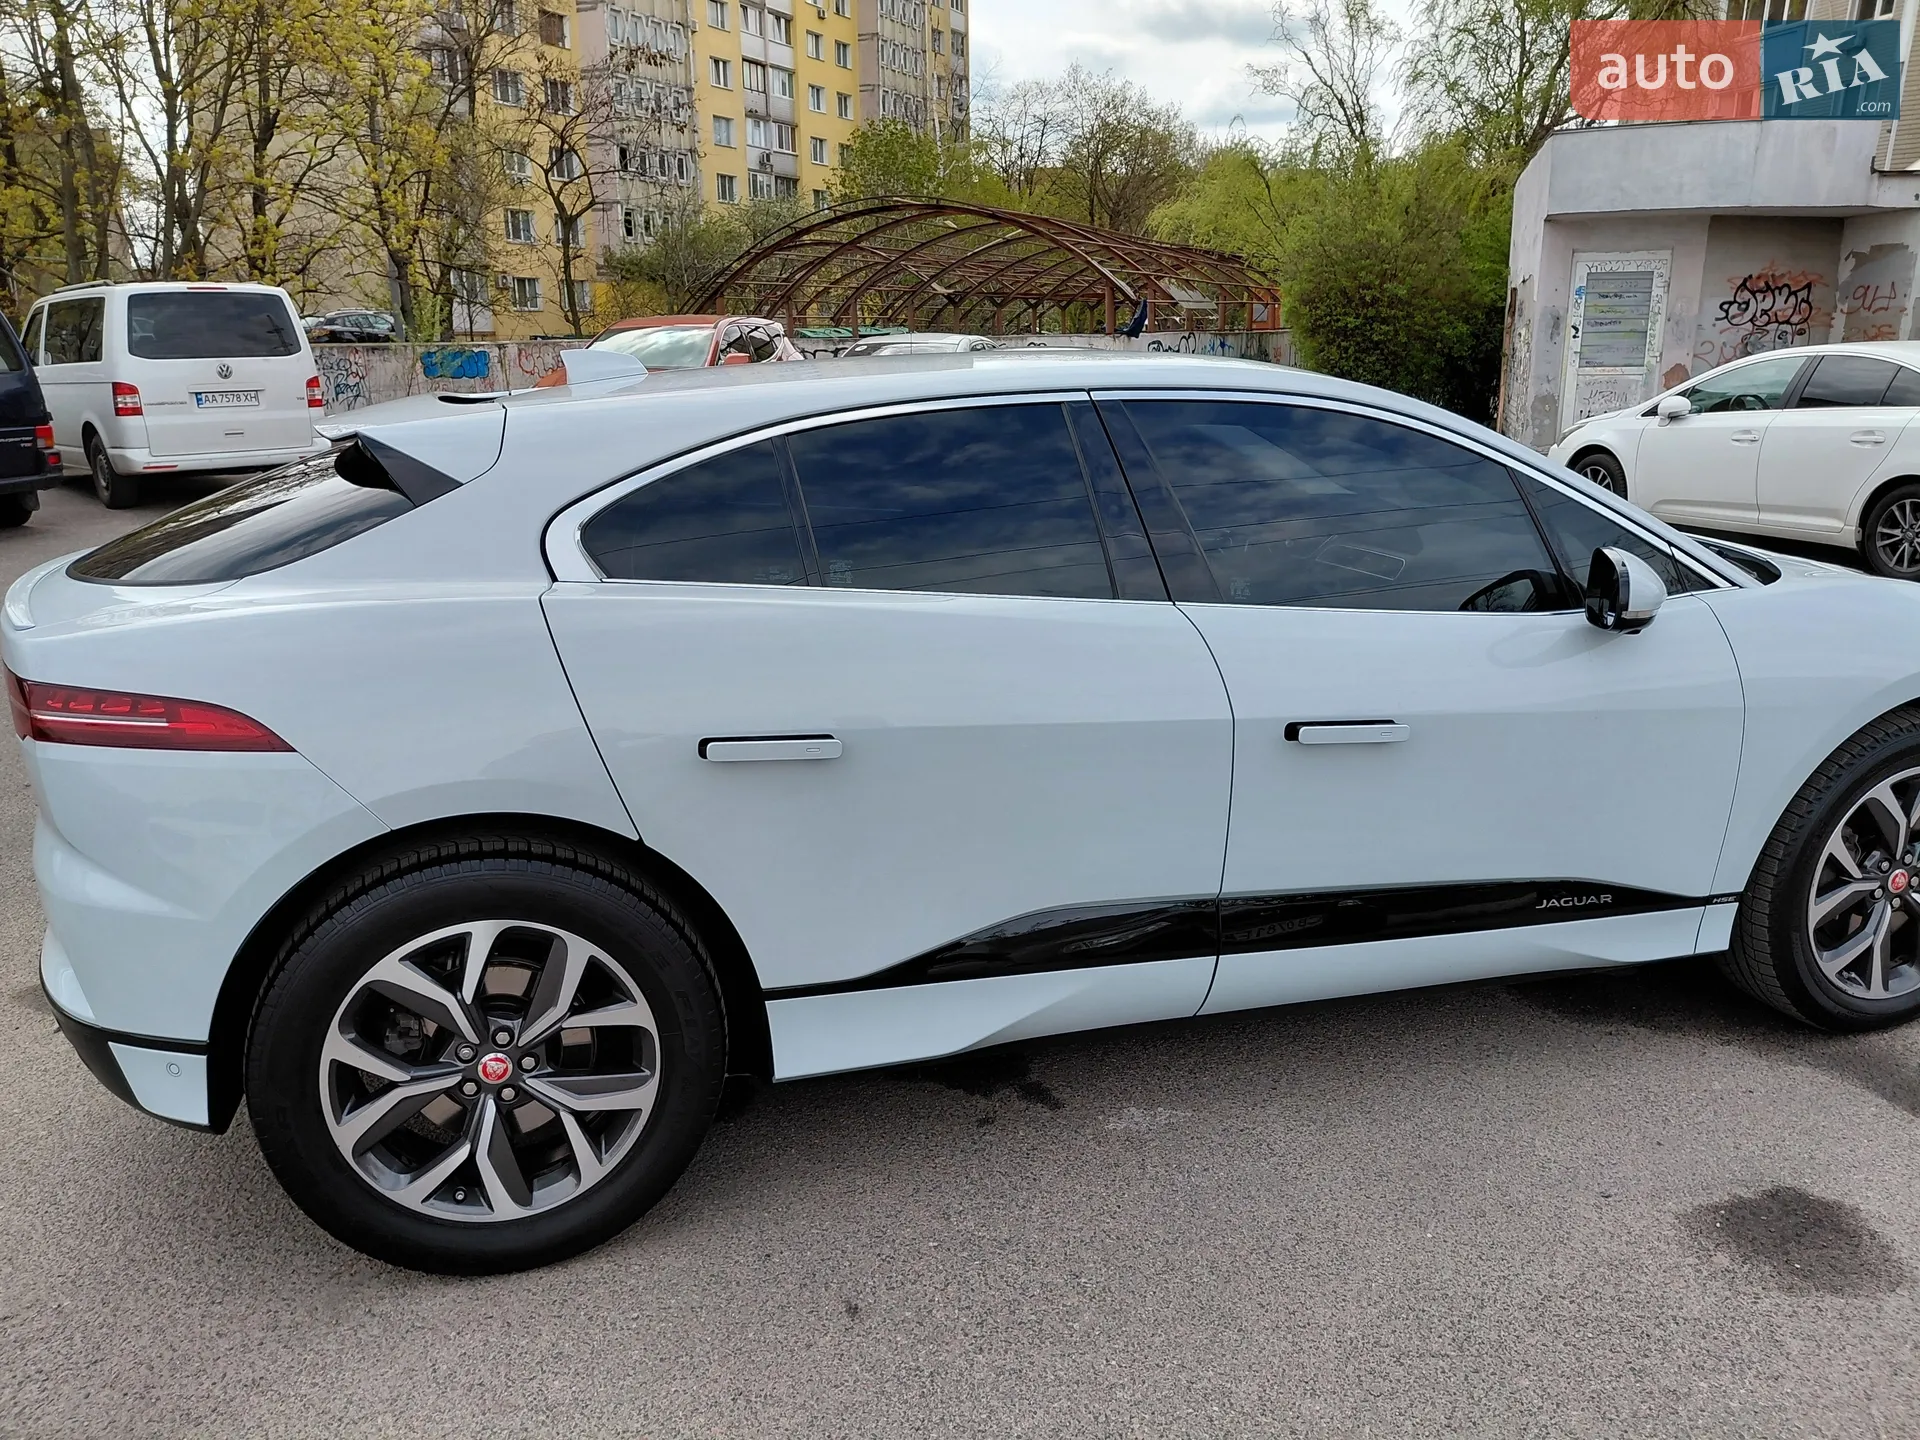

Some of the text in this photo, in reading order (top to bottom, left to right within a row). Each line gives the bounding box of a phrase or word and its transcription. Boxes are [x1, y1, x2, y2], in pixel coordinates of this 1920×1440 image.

[204, 392, 257, 404] AA 7578 XH
[1535, 894, 1613, 909] JAGUAR
[1712, 896, 1737, 904] HSE
